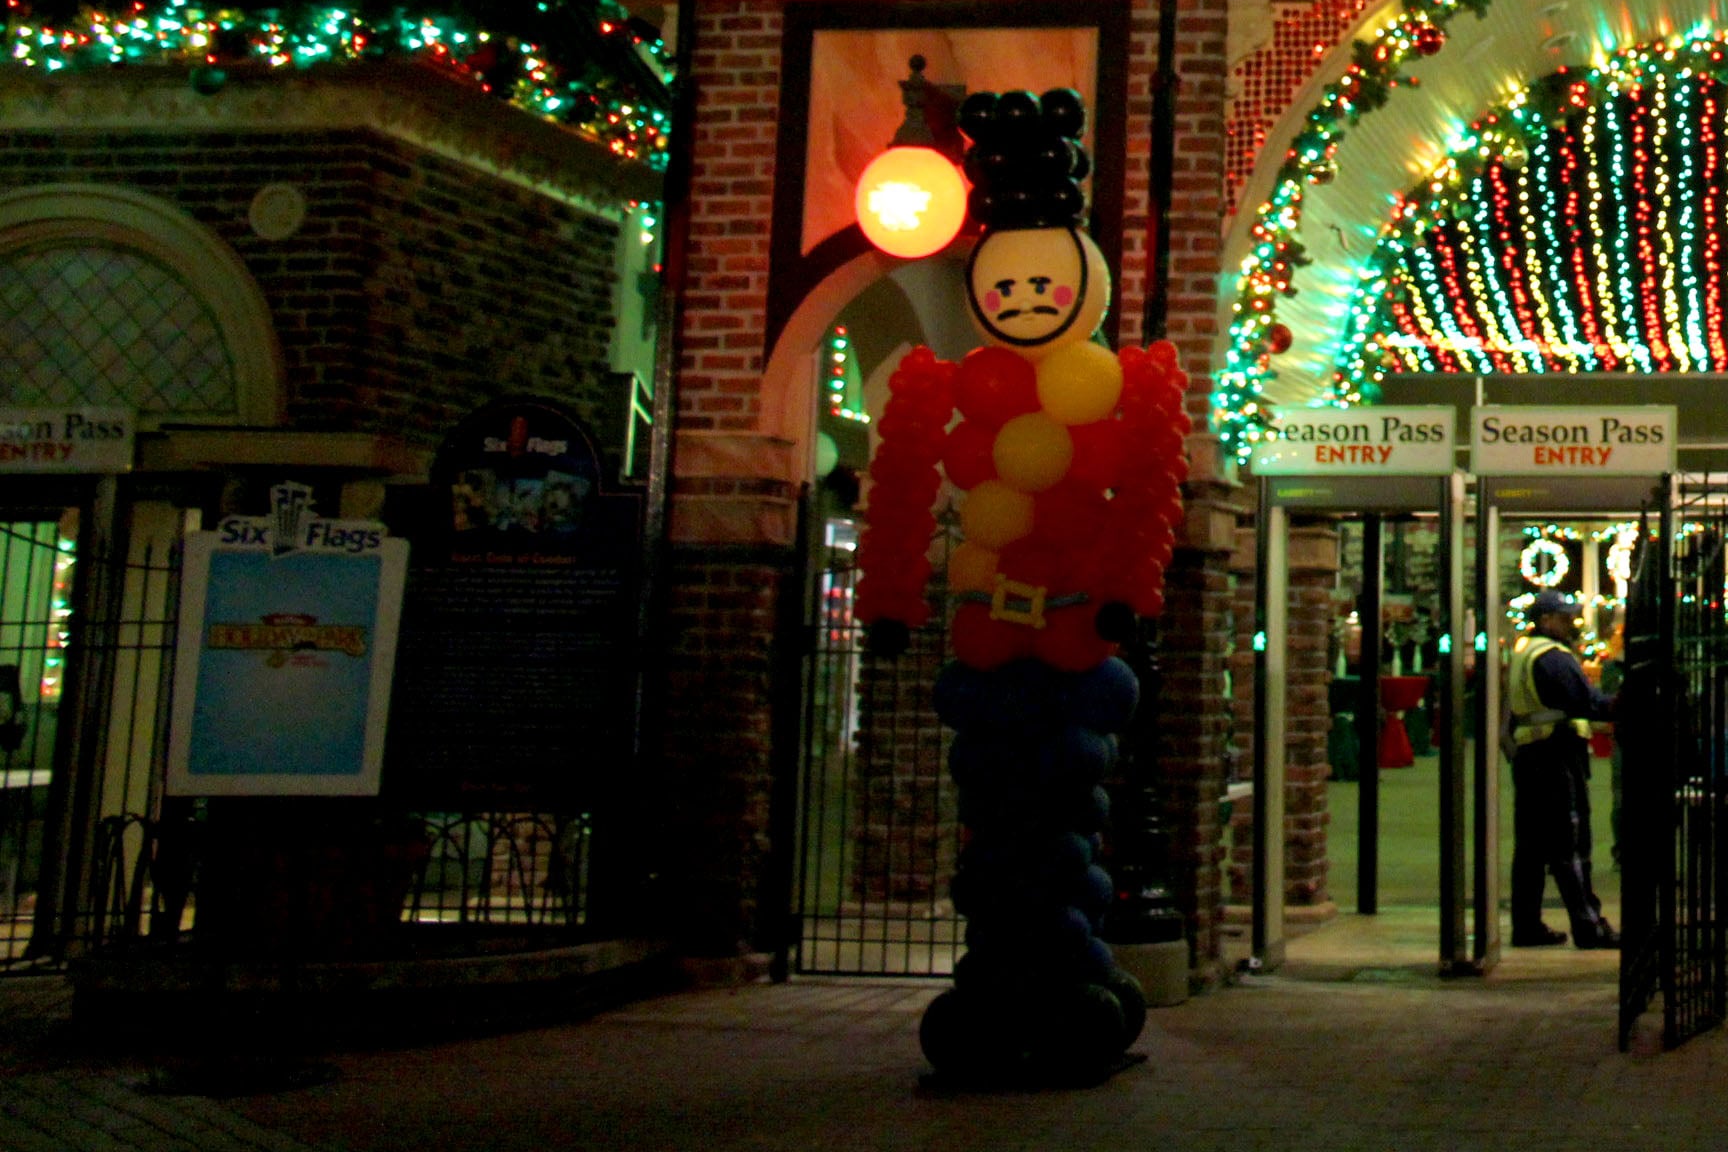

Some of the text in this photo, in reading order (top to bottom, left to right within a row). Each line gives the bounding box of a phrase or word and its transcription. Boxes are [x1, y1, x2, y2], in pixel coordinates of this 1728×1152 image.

[66, 414, 124, 440] Pass
[1382, 417, 1445, 443] Pass
[1481, 417, 1664, 444] Season Pass
[1315, 445, 1393, 464] ENTRY
[1534, 446, 1612, 466] ENTRY
[222, 520, 380, 552] Six Flags
